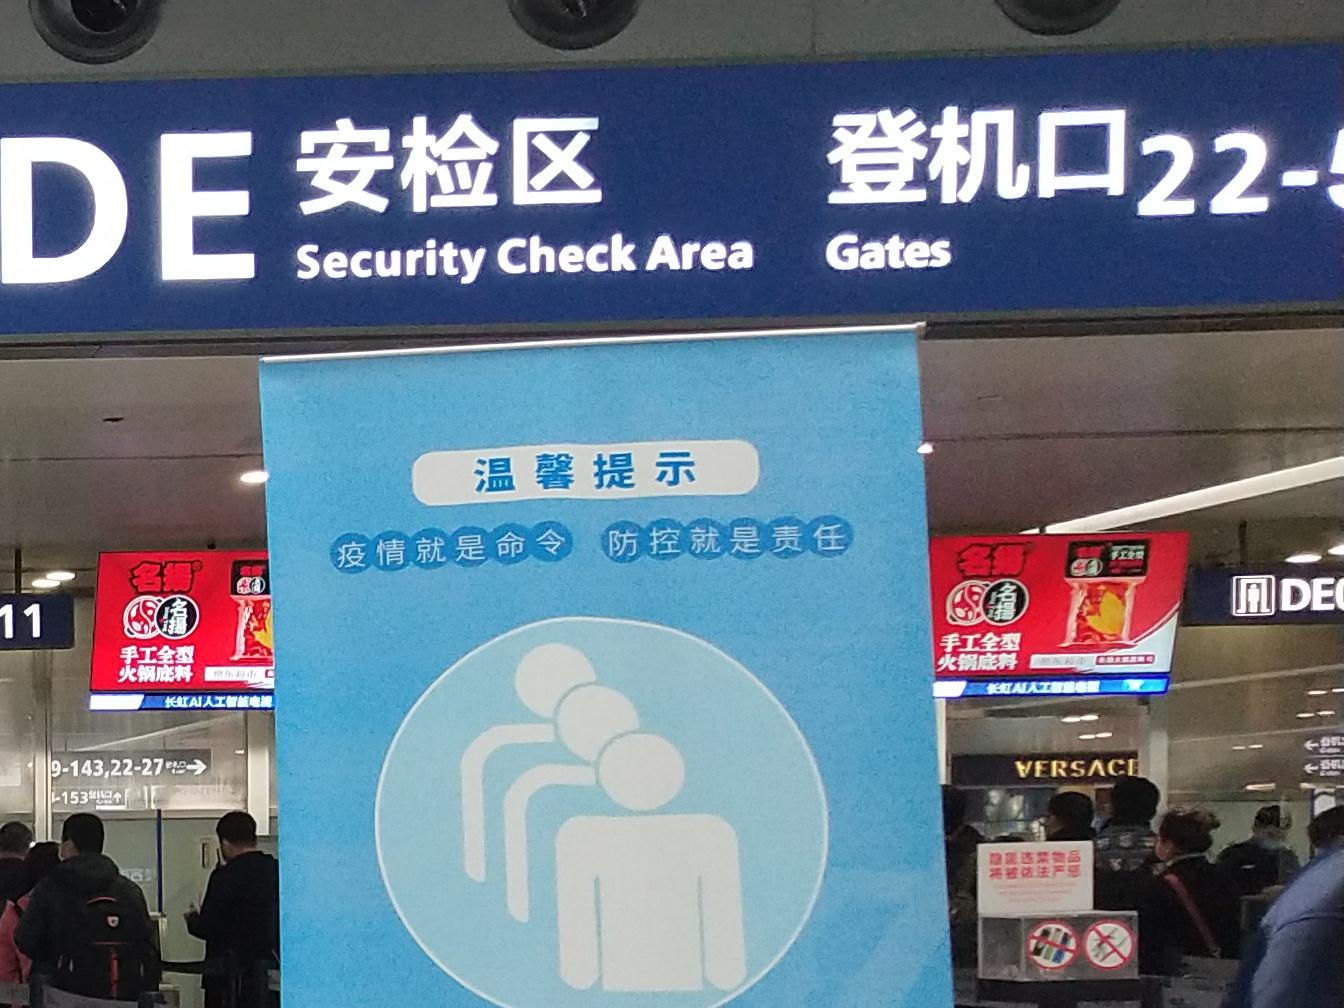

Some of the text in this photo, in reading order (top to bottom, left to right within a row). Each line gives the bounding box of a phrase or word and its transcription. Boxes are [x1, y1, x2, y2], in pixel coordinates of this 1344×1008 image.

[296, 114, 604, 215] 安检区
[826, 105, 1127, 205] 登机口
[296, 233, 755, 285] Security Check Area
[825, 232, 953, 271] Gates
[473, 450, 697, 494] 温馨提示
[337, 520, 850, 570] 疫情就是命令 防控就是责任
[119, 645, 195, 664] 手工全型
[936, 652, 1018, 672] 火锅底料
[939, 632, 1022, 652] 手工全型
[118, 665, 194, 683] 火锅底料
